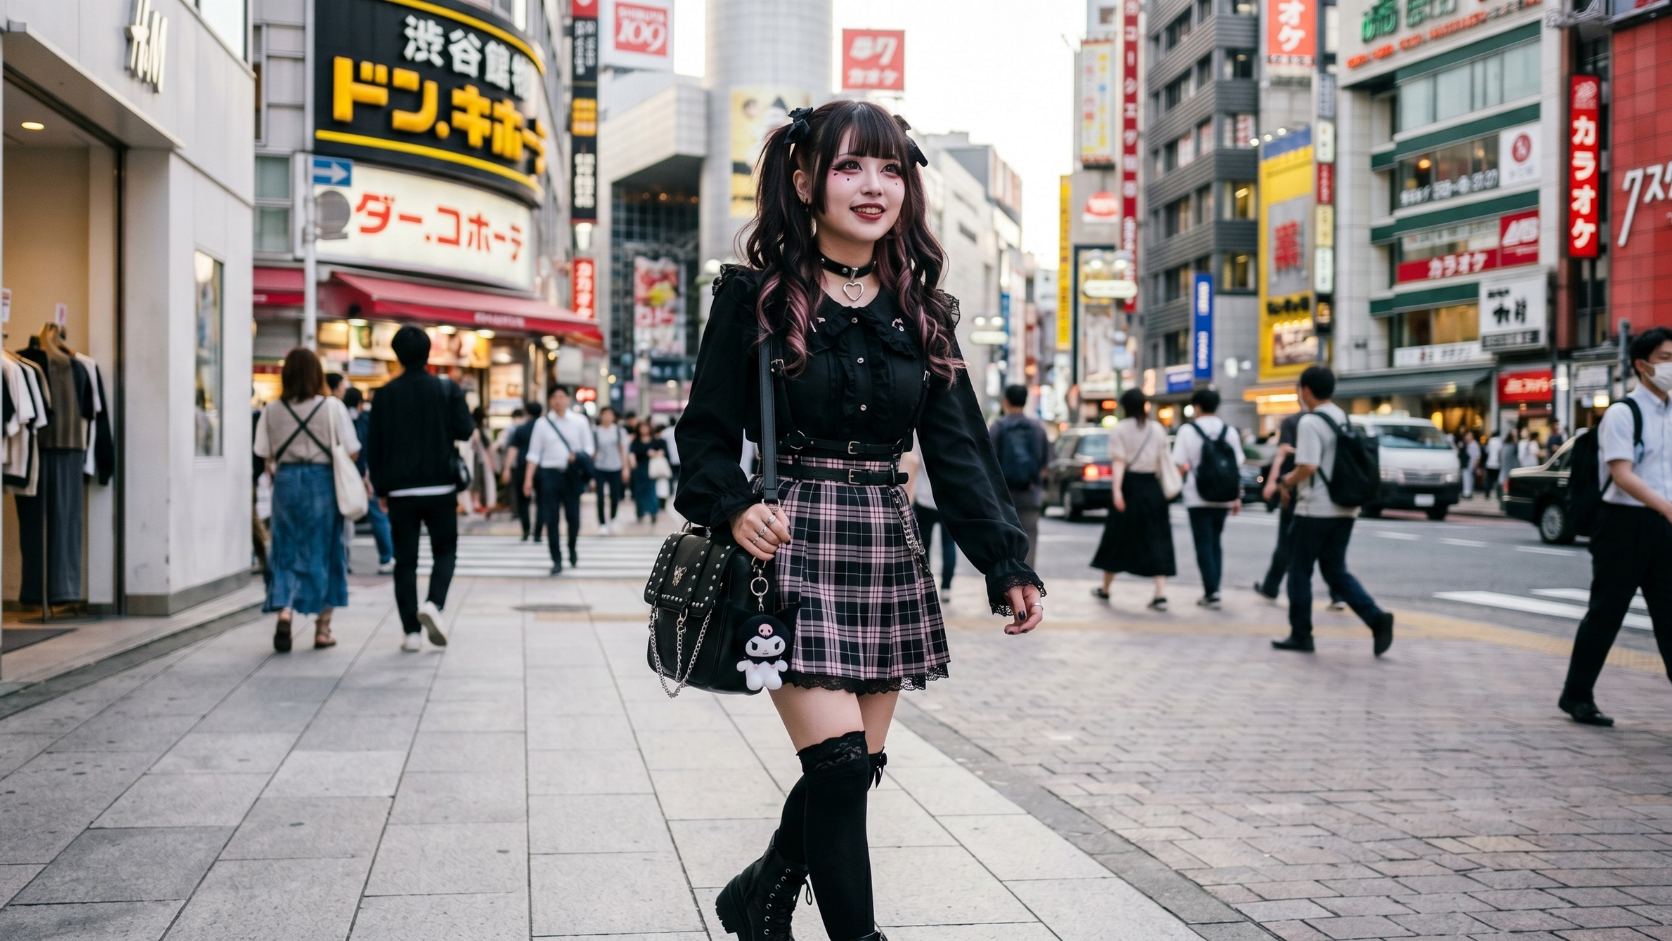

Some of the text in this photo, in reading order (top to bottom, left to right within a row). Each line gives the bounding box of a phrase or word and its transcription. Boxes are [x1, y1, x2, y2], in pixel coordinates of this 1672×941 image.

[617, 17, 666, 53] 109
[1571, 115, 1597, 249] カラオケ
[1427, 251, 1489, 279] カラオケ
